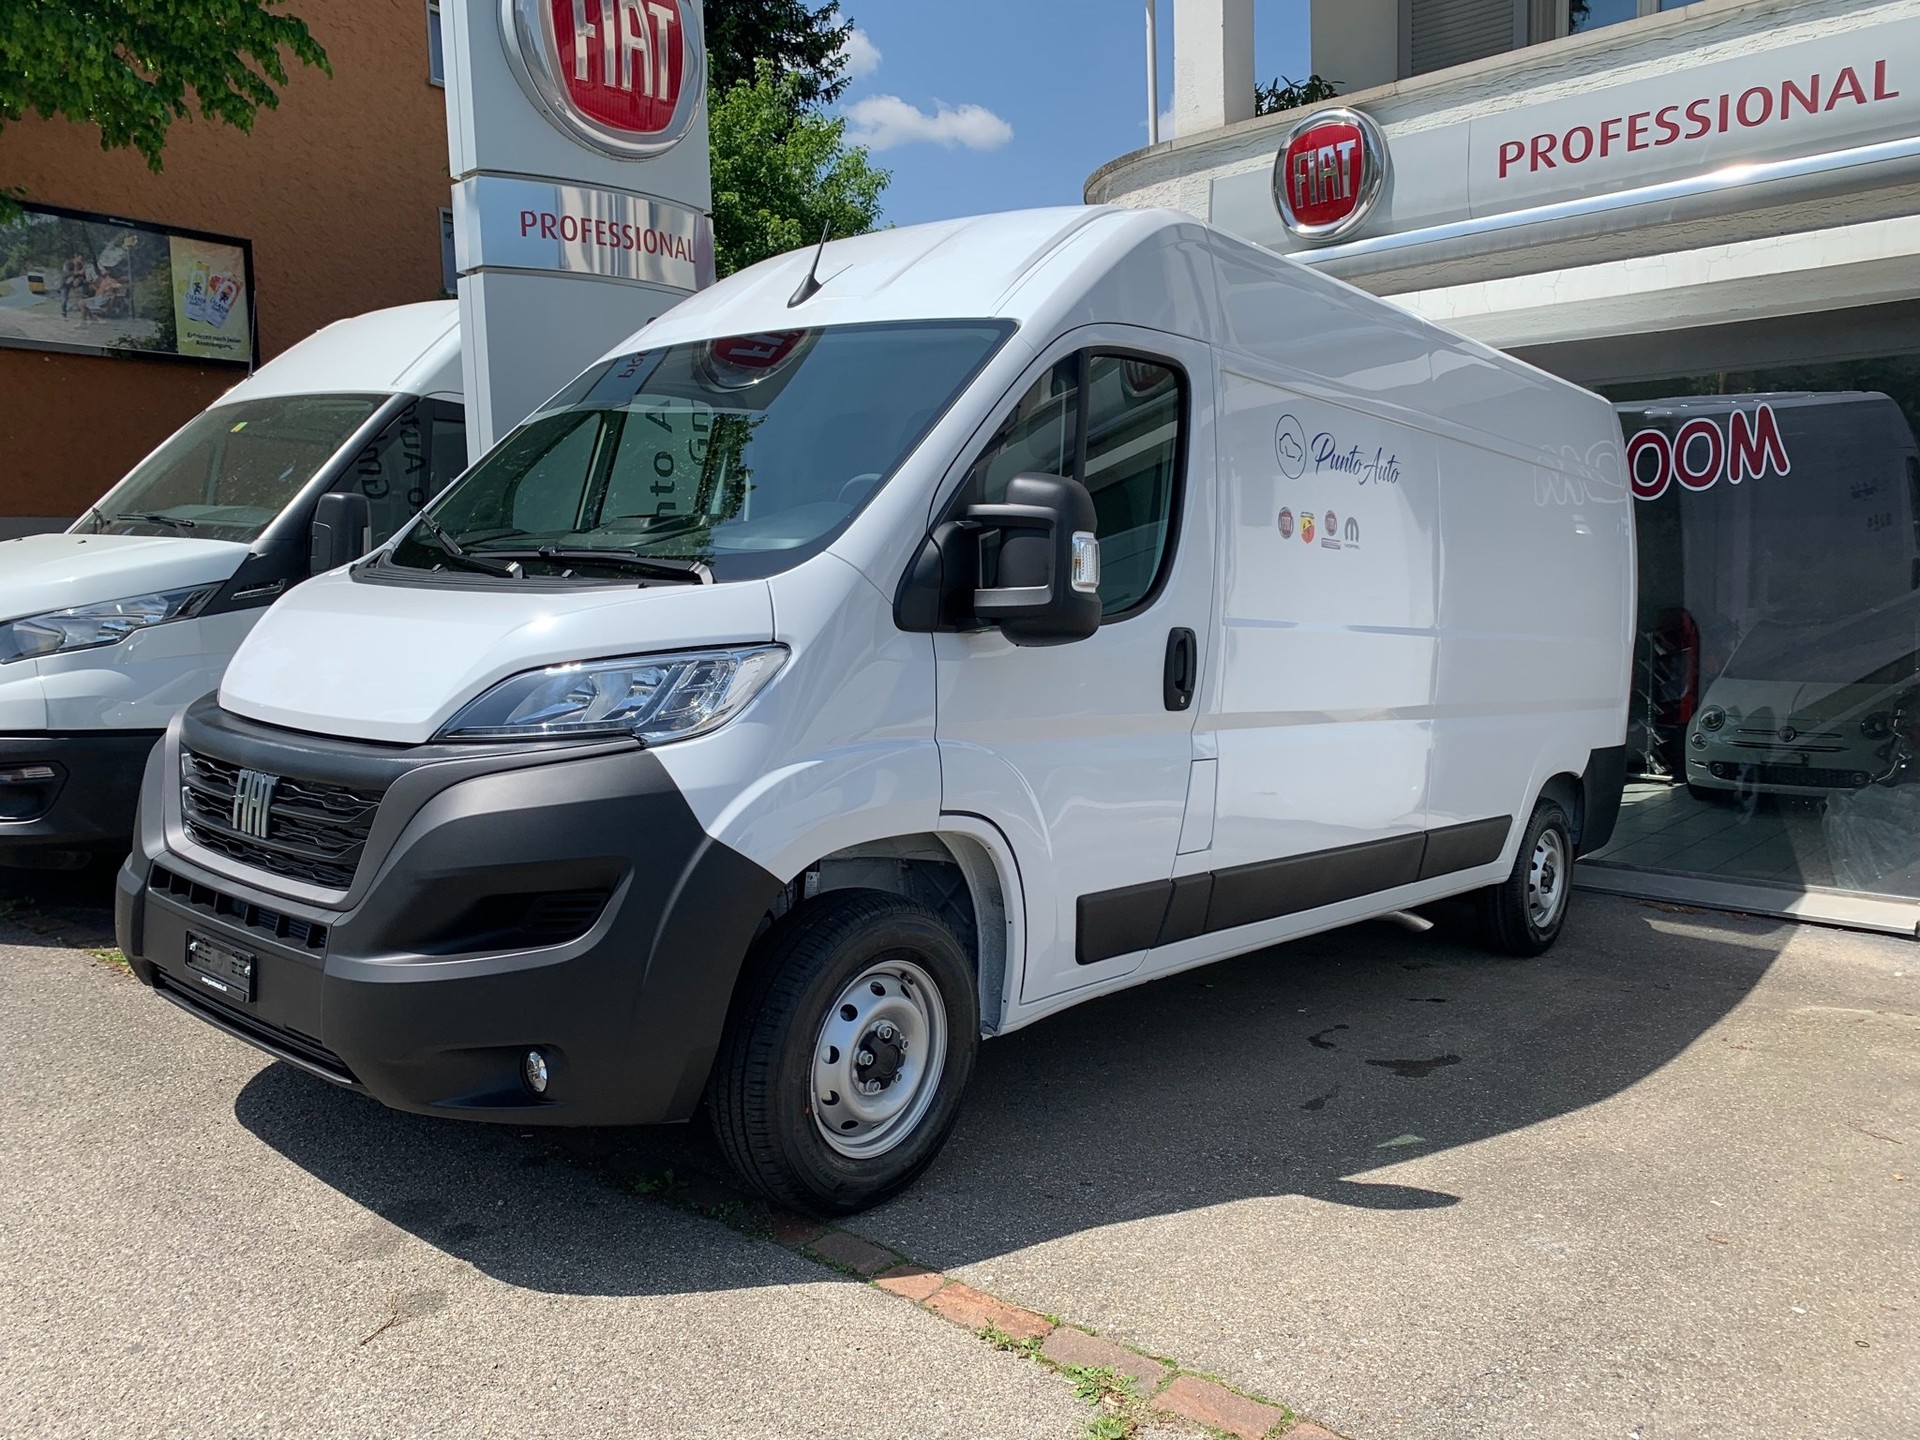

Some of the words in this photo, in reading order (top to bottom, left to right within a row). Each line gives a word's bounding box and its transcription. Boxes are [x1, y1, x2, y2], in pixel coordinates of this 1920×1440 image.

[572, 0, 674, 101] FIAT
[1499, 59, 1900, 178] PROFESSIONAL
[1293, 139, 1356, 209] FIAT
[520, 210, 696, 264] PROFESSIONAL
[1311, 432, 1364, 475] Punto
[1358, 447, 1401, 485] Auto
[232, 769, 279, 838] FIAT
